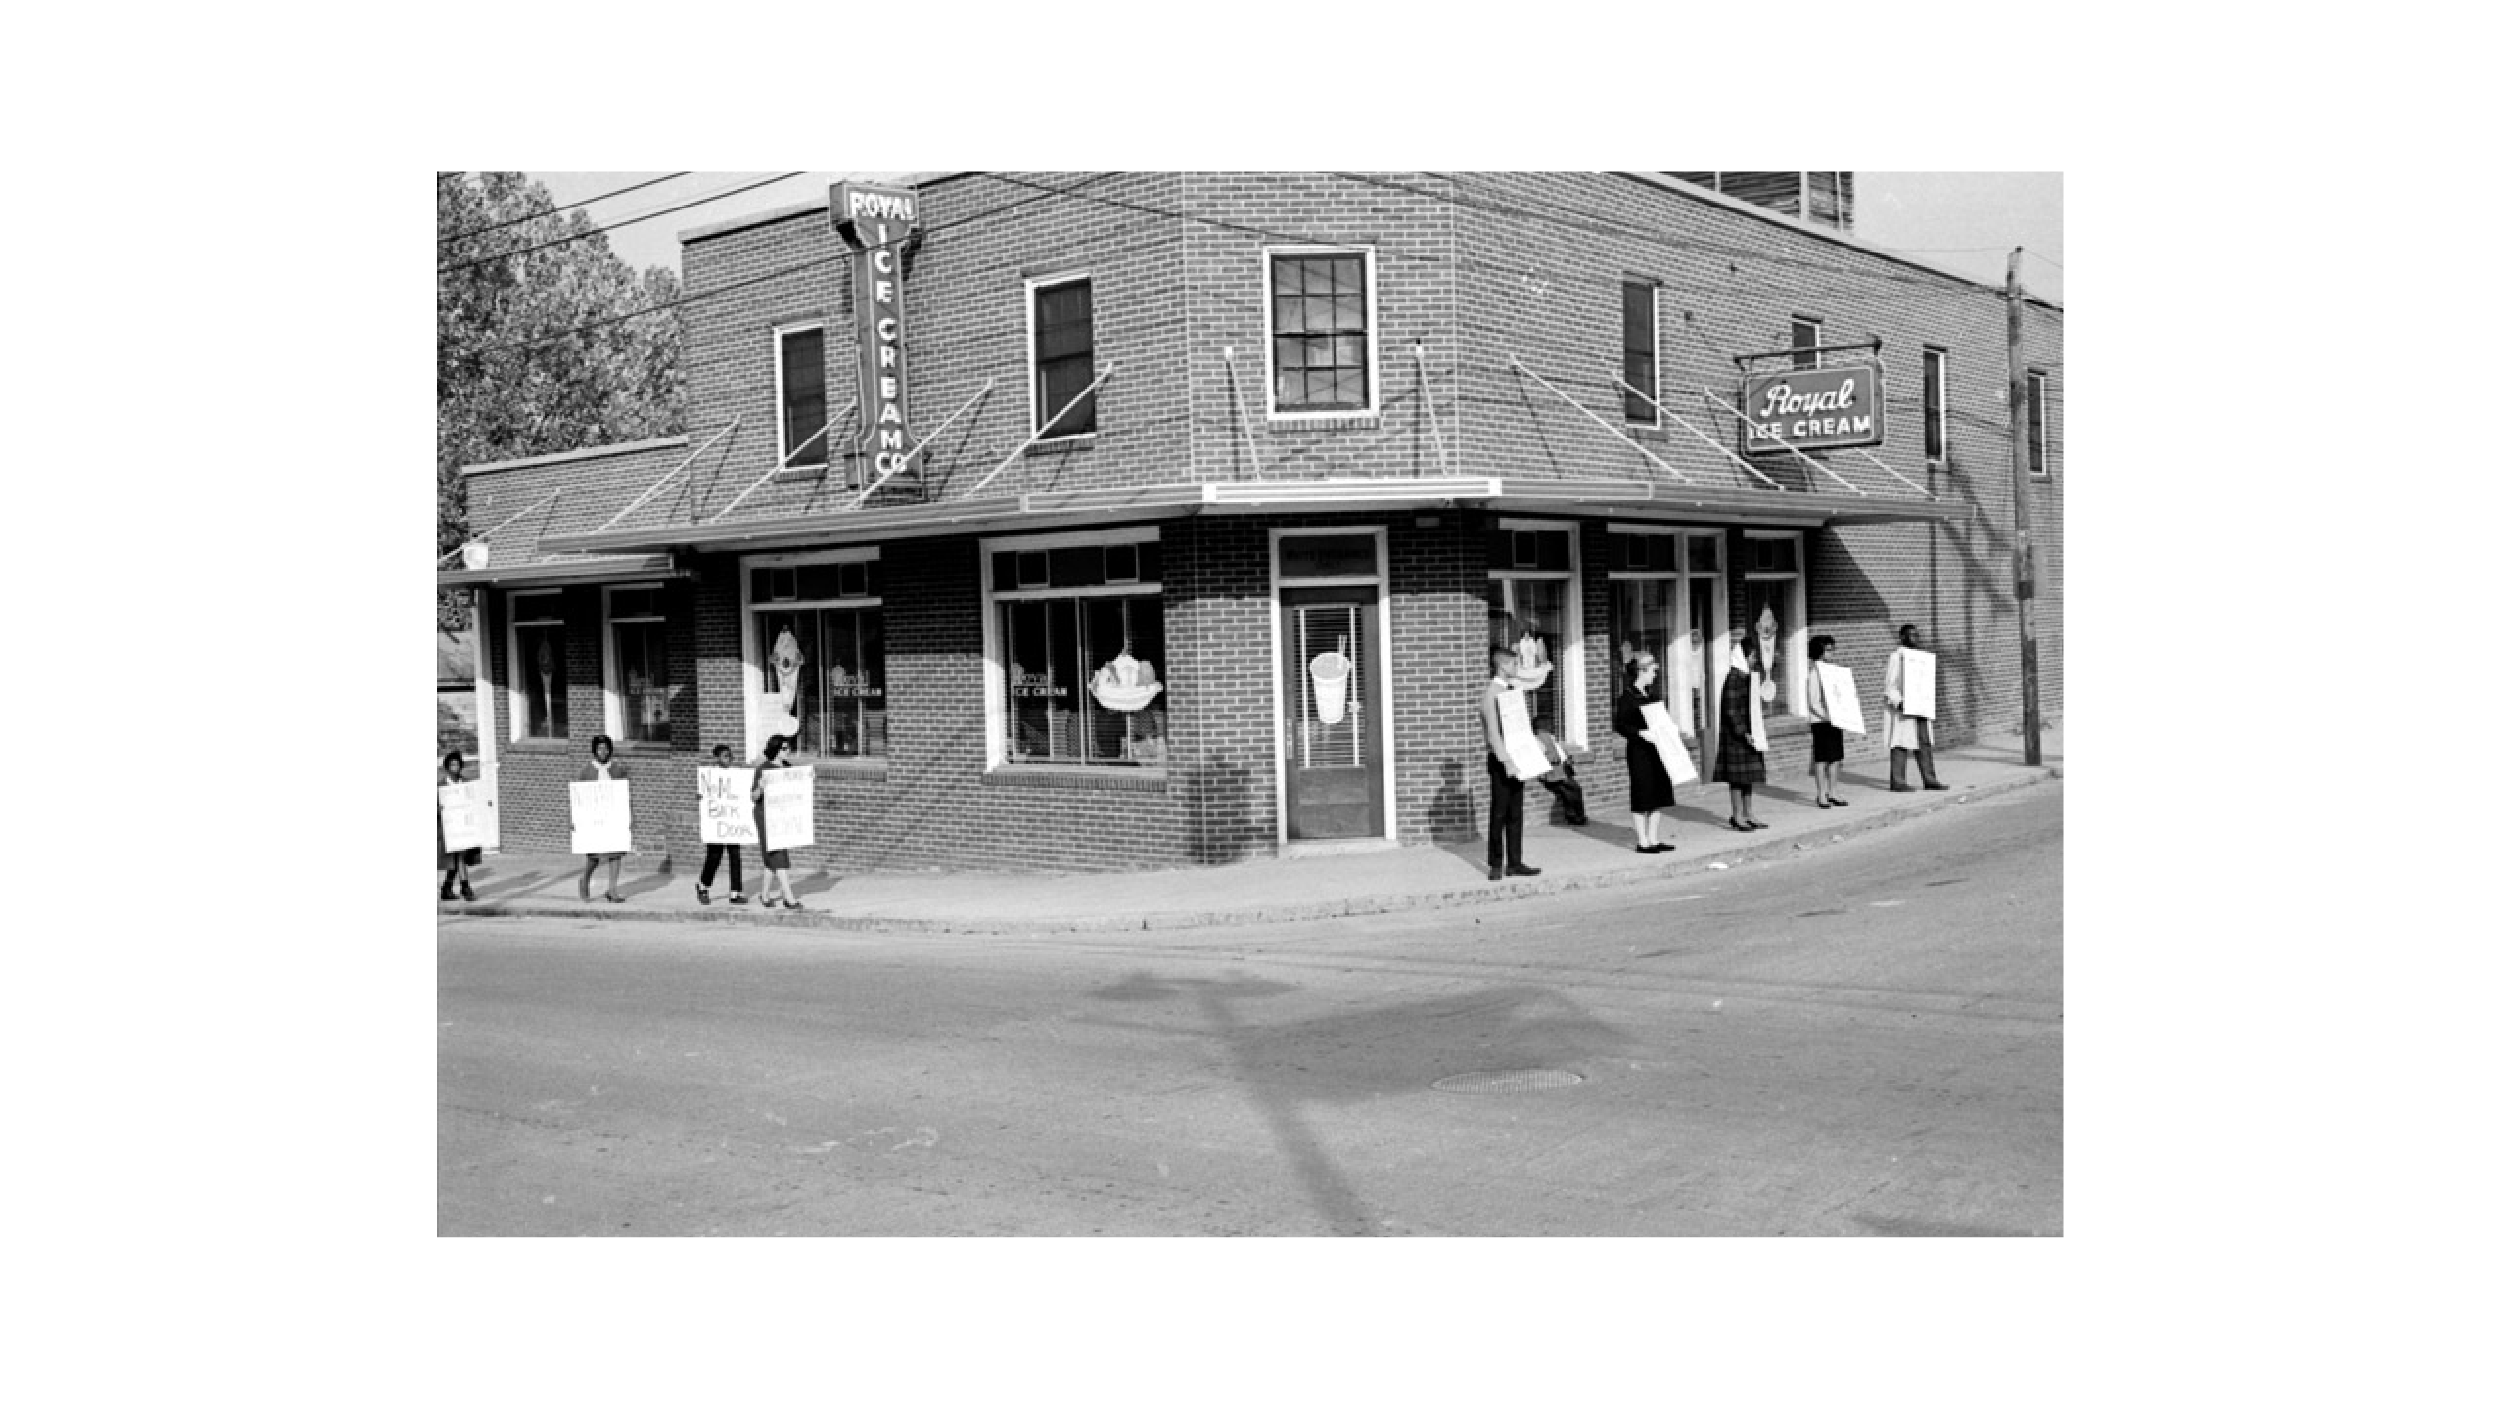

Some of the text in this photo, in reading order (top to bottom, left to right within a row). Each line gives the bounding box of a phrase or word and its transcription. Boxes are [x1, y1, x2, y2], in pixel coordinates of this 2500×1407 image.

[849, 191, 917, 221] ROYAL
[874, 223, 902, 450] ICE CREAM
[1759, 378, 1855, 417] Royal
[1748, 415, 1871, 440] ICE CREAM
